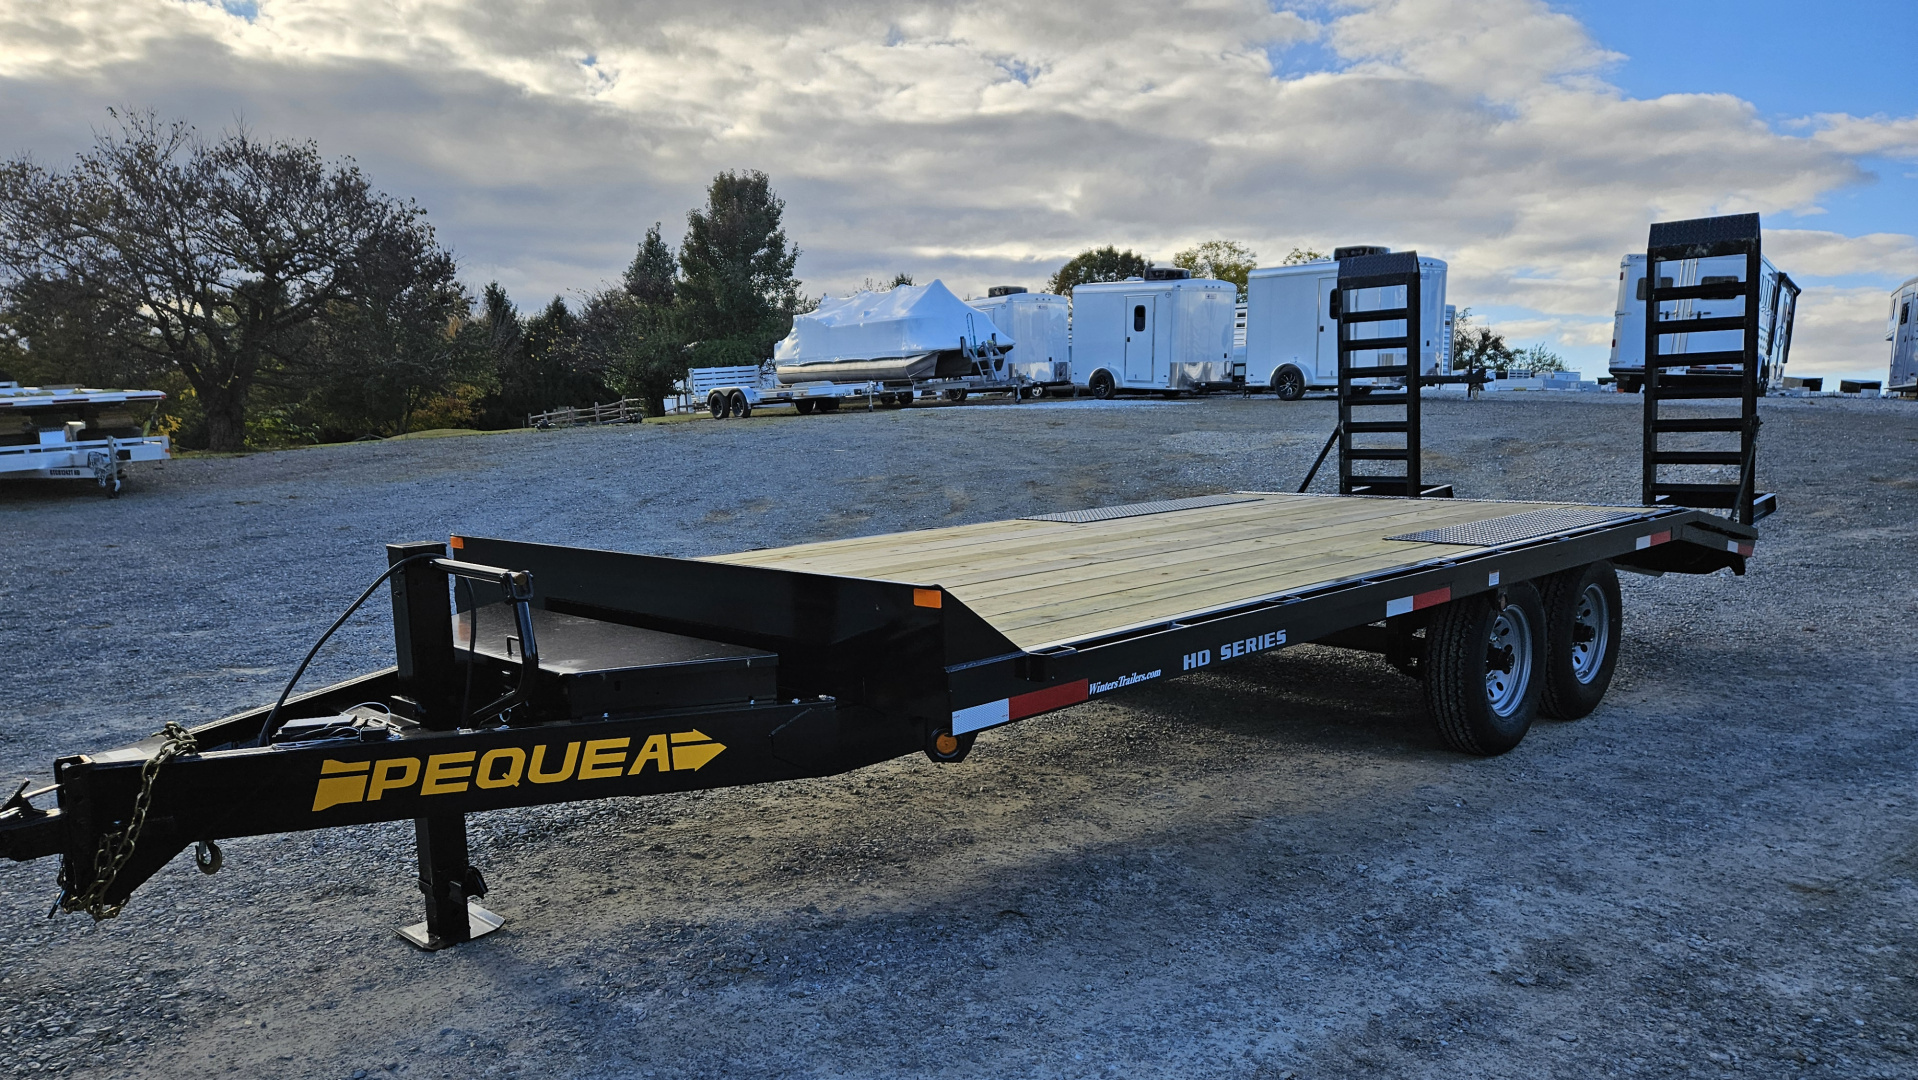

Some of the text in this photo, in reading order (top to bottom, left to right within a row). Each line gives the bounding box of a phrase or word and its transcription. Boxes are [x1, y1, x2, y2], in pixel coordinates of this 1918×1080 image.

[1183, 629, 1286, 671] HD SERIES
[367, 734, 670, 801] PEQUEA
